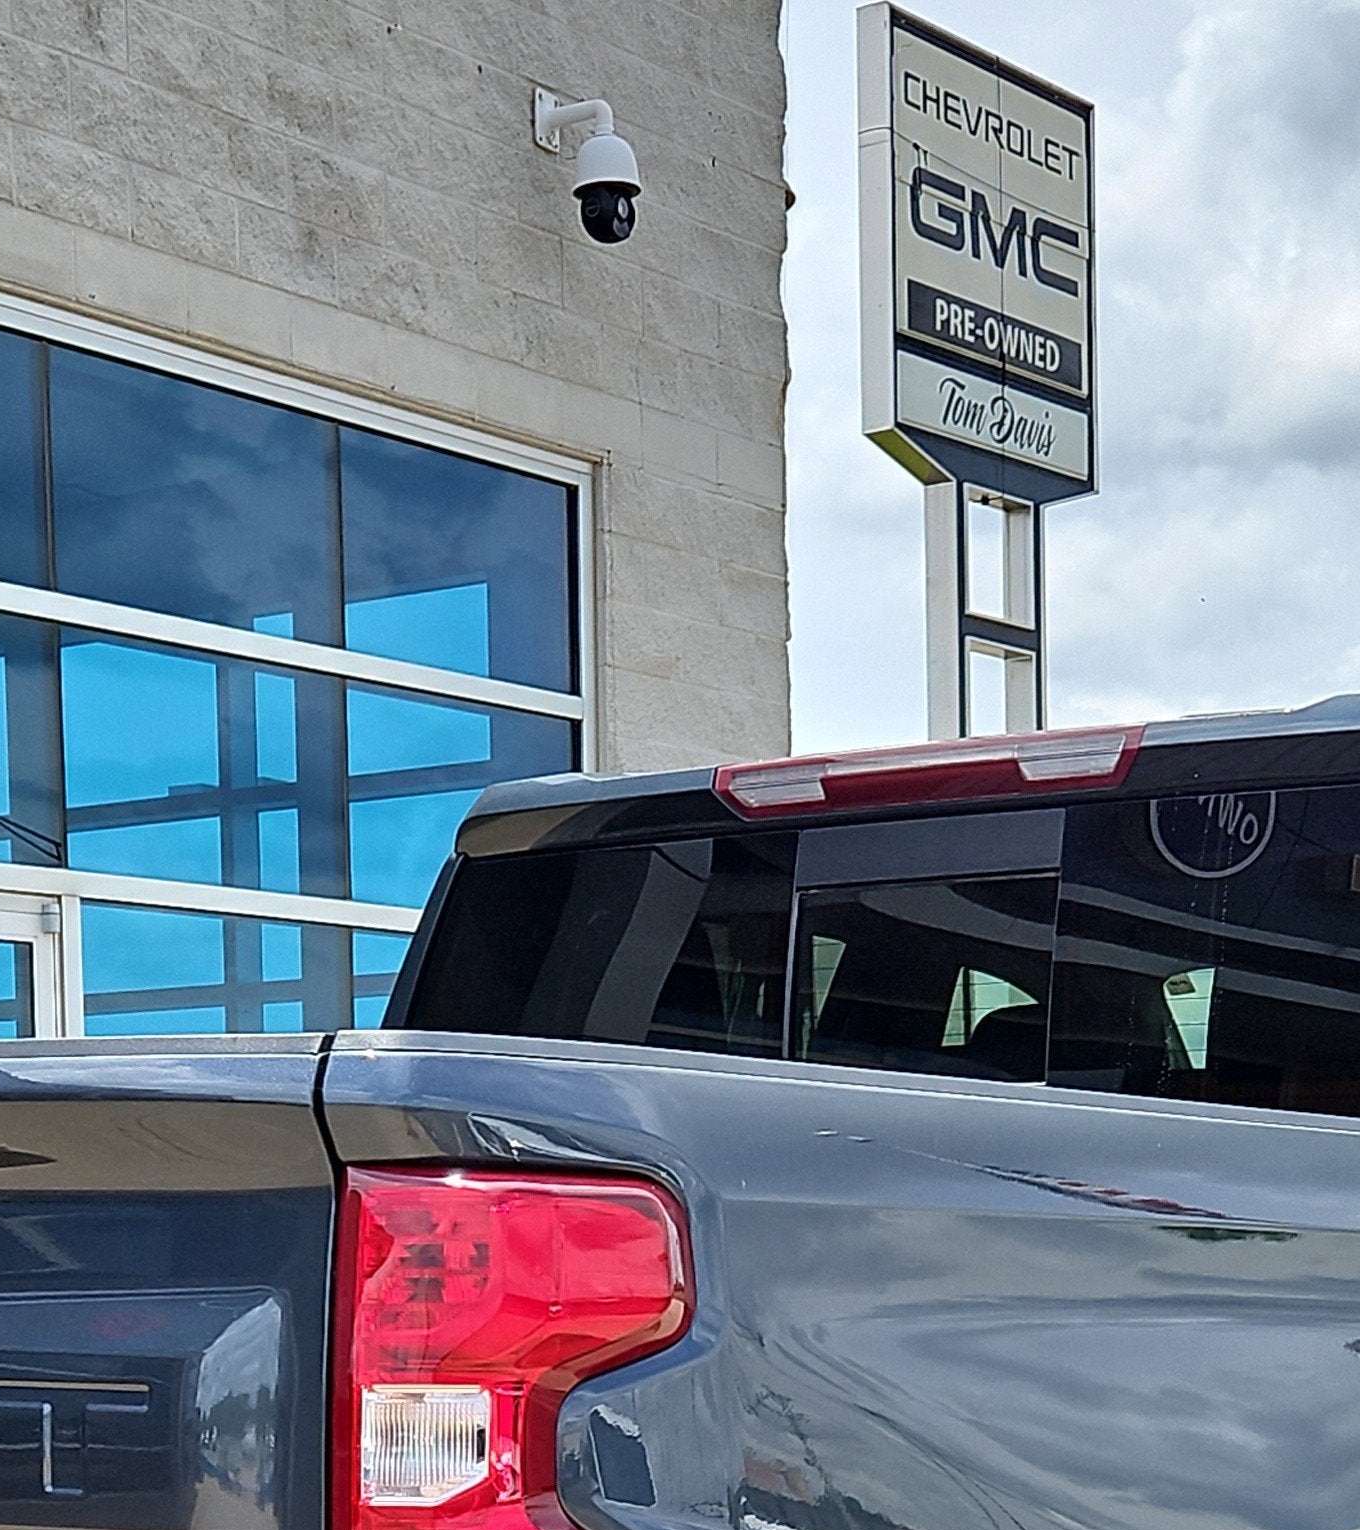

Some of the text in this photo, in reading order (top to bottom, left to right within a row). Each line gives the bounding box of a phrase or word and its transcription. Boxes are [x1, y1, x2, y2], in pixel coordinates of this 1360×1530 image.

[903, 70, 1081, 181] CHEVROLET
[910, 165, 1080, 298] GMC
[934, 297, 1061, 373] PRE-OWNED
[939, 377, 1058, 458] Tom Davis
